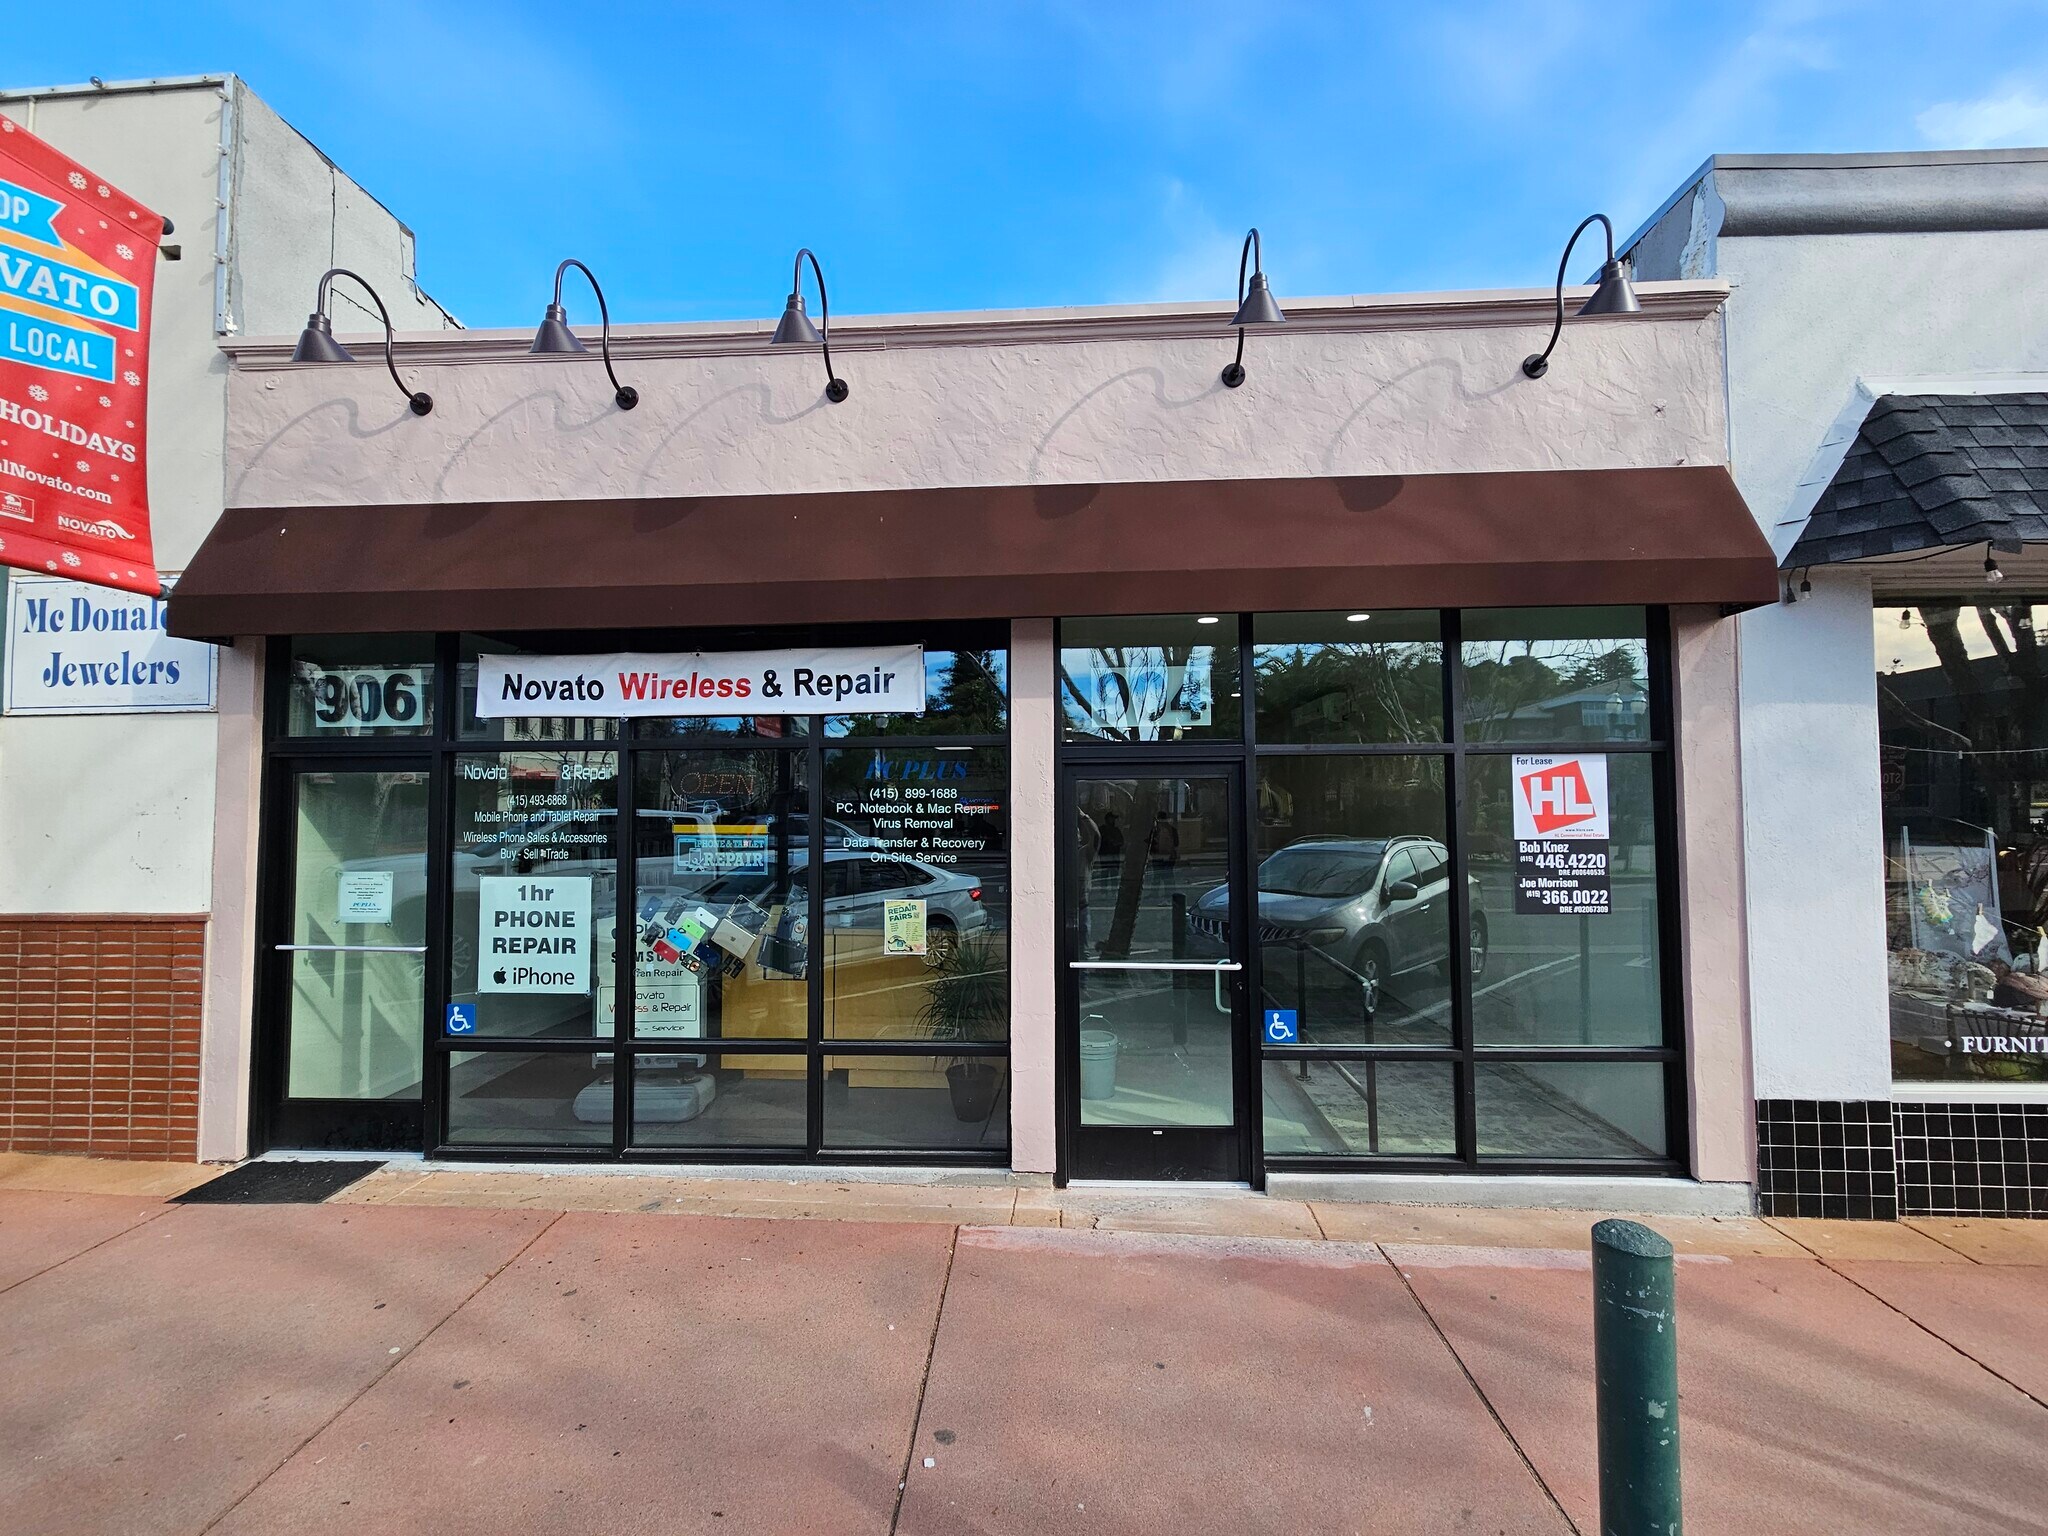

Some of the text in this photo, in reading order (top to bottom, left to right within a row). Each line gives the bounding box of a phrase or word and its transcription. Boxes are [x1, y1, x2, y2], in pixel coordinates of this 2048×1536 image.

[0, 252, 120, 316] VATO
[9, 322, 98, 370] LOCAL
[0, 398, 136, 463] HOLIDAYS
[58, 515, 117, 539] NOVATO
[43, 651, 181, 687] Jewelers
[502, 666, 896, 701] Novato Wireless & Repair
[315, 673, 417, 722] 906
[1516, 757, 1553, 765] For Lease
[464, 764, 613, 783] Novato & Repair
[900, 759, 969, 780] PLUS
[680, 772, 756, 795] OPEN
[507, 794, 568, 808] (415) 493-6868
[869, 788, 958, 801] (415) 899-1688
[1530, 776, 1594, 816] HL
[836, 803, 857, 814] PC,
[860, 803, 913, 814] Notebook
[915, 803, 925, 814] &
[927, 803, 951, 814] Mac
[954, 803, 991, 816] Repair
[474, 811, 600, 824] Mobile Phone and Tablet Repair
[872, 818, 954, 829] Virus Removal
[463, 831, 608, 843] Wireless Phone Sales & Accessories
[696, 839, 725, 848] PHONE
[843, 838, 986, 850] Data Transfer & Recovery
[1520, 841, 1569, 853] Bob Knez
[500, 849, 517, 862] Buy
[523, 849, 539, 860] Sell
[546, 849, 569, 860] Trade
[703, 852, 764, 867] REPAIR
[870, 852, 957, 863] On-Site Service
[1520, 854, 1606, 869] (415) 446.4220
[1519, 877, 1579, 888] Joe Morrison
[517, 884, 554, 901] 1hr
[1526, 889, 1609, 905] (415) 366.0022
[1559, 905, 1573, 913] DRE
[494, 911, 576, 928] PHONE
[492, 937, 577, 955] REPAIR
[512, 967, 575, 985] iPhone
[653, 968, 684, 978] Repair
[634, 991, 665, 1000] ovato
[652, 1004, 659, 1012] &
[660, 1002, 692, 1013] Repair
[1961, 1036, 2048, 1053] FURNIT
